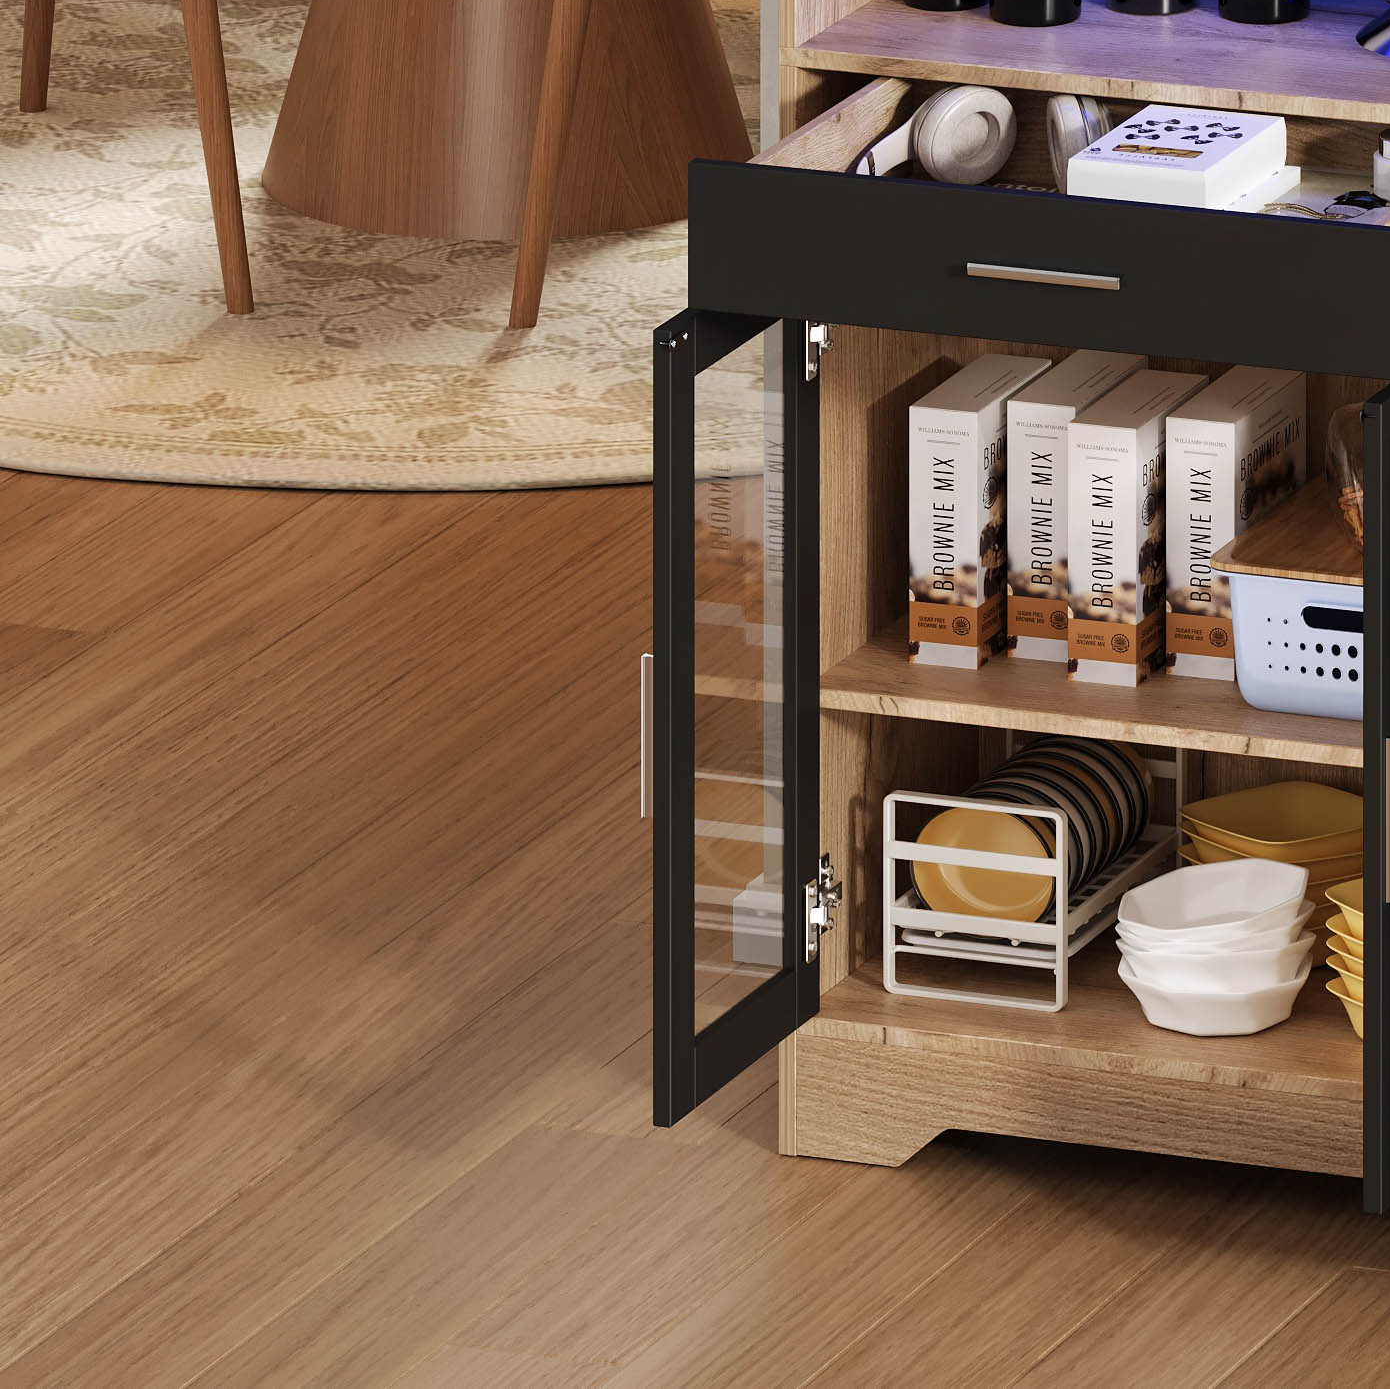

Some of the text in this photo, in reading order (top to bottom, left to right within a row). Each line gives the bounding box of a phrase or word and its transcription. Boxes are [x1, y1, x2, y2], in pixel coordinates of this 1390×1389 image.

[1241, 431, 1281, 482] BROWNIE
[1284, 417, 1301, 450] MIX
[932, 456, 955, 592] BROWNIE MIX
[1031, 451, 1053, 586] BROWNIE MIX
[1092, 473, 1113, 609] BROWNIE MIX
[1190, 468, 1212, 603] BROWNIE MIX
